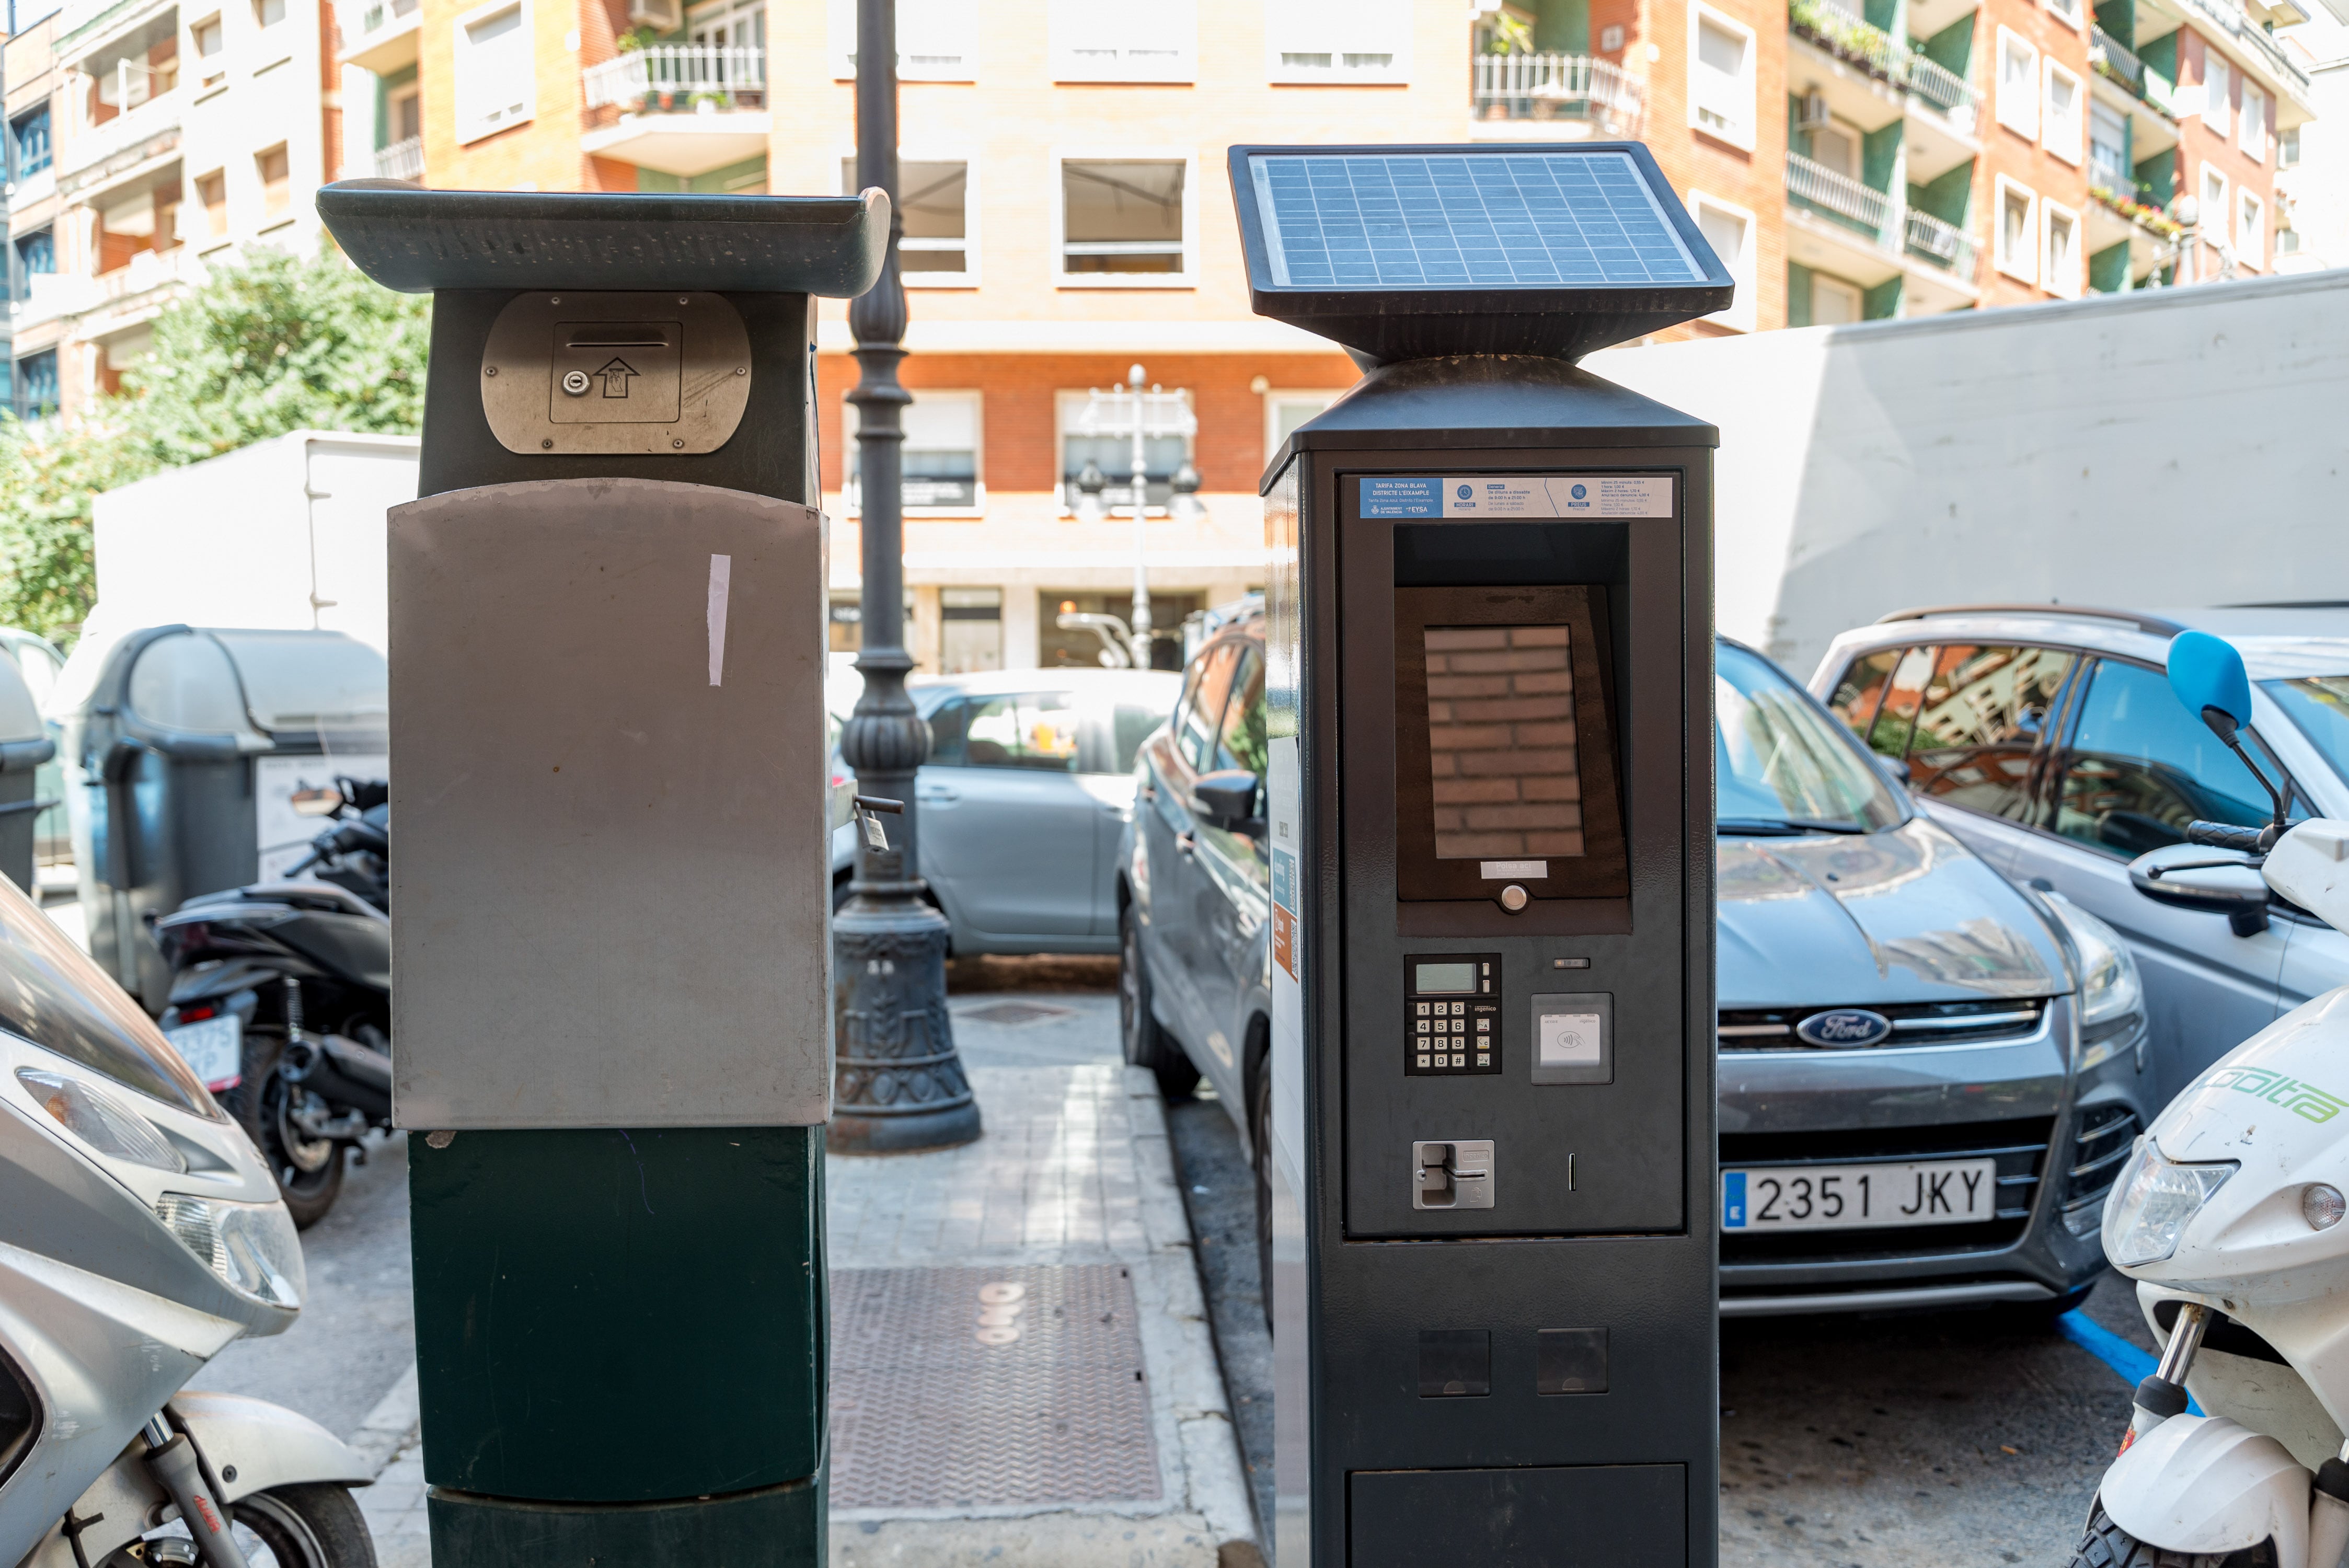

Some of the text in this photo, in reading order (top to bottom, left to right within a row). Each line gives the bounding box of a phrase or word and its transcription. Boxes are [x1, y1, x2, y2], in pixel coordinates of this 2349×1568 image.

[1821, 1015, 1872, 1040] Ford
[1729, 1170, 1983, 1221] E 2351 JKY
